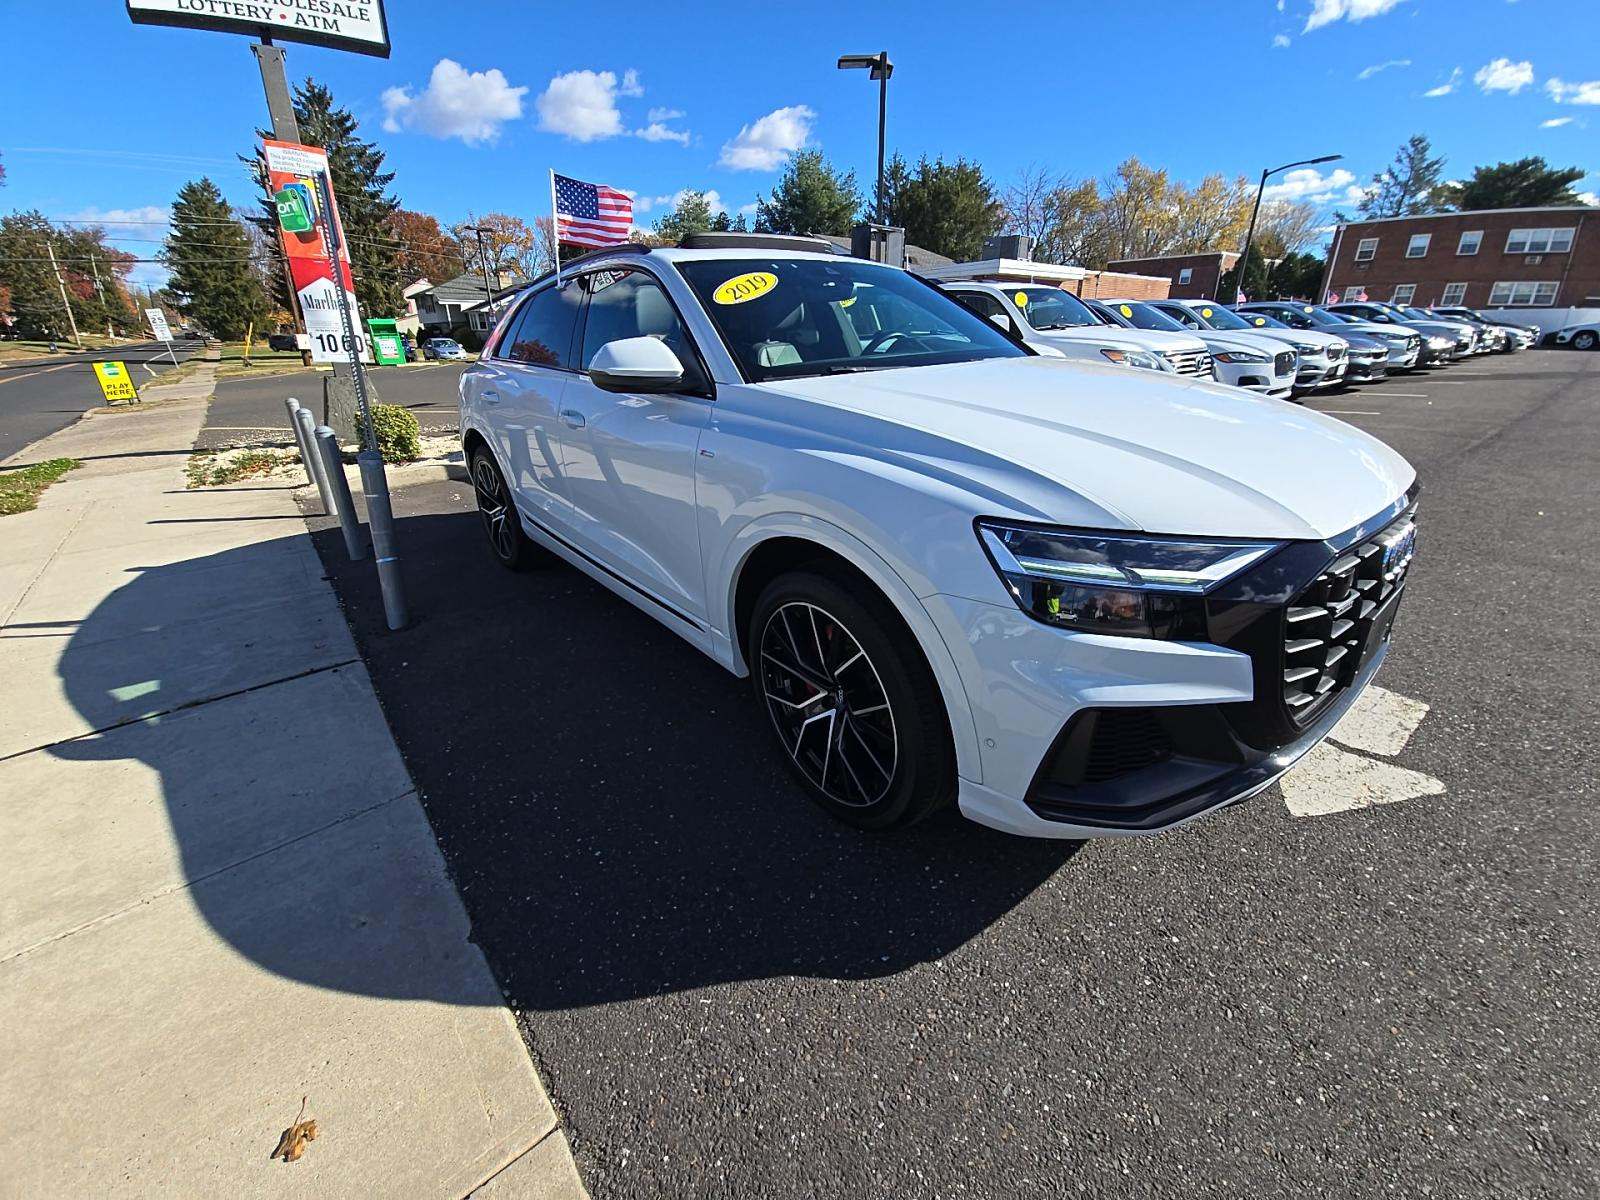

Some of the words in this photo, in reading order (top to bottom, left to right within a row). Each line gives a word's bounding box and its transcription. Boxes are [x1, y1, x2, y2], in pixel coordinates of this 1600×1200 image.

[177, 0, 273, 20] LOTTERY
[295, 12, 341, 32] ATM
[254, 0, 370, 21] OLESALE
[725, 275, 767, 300] 2019
[151, 317, 165, 325] 25
